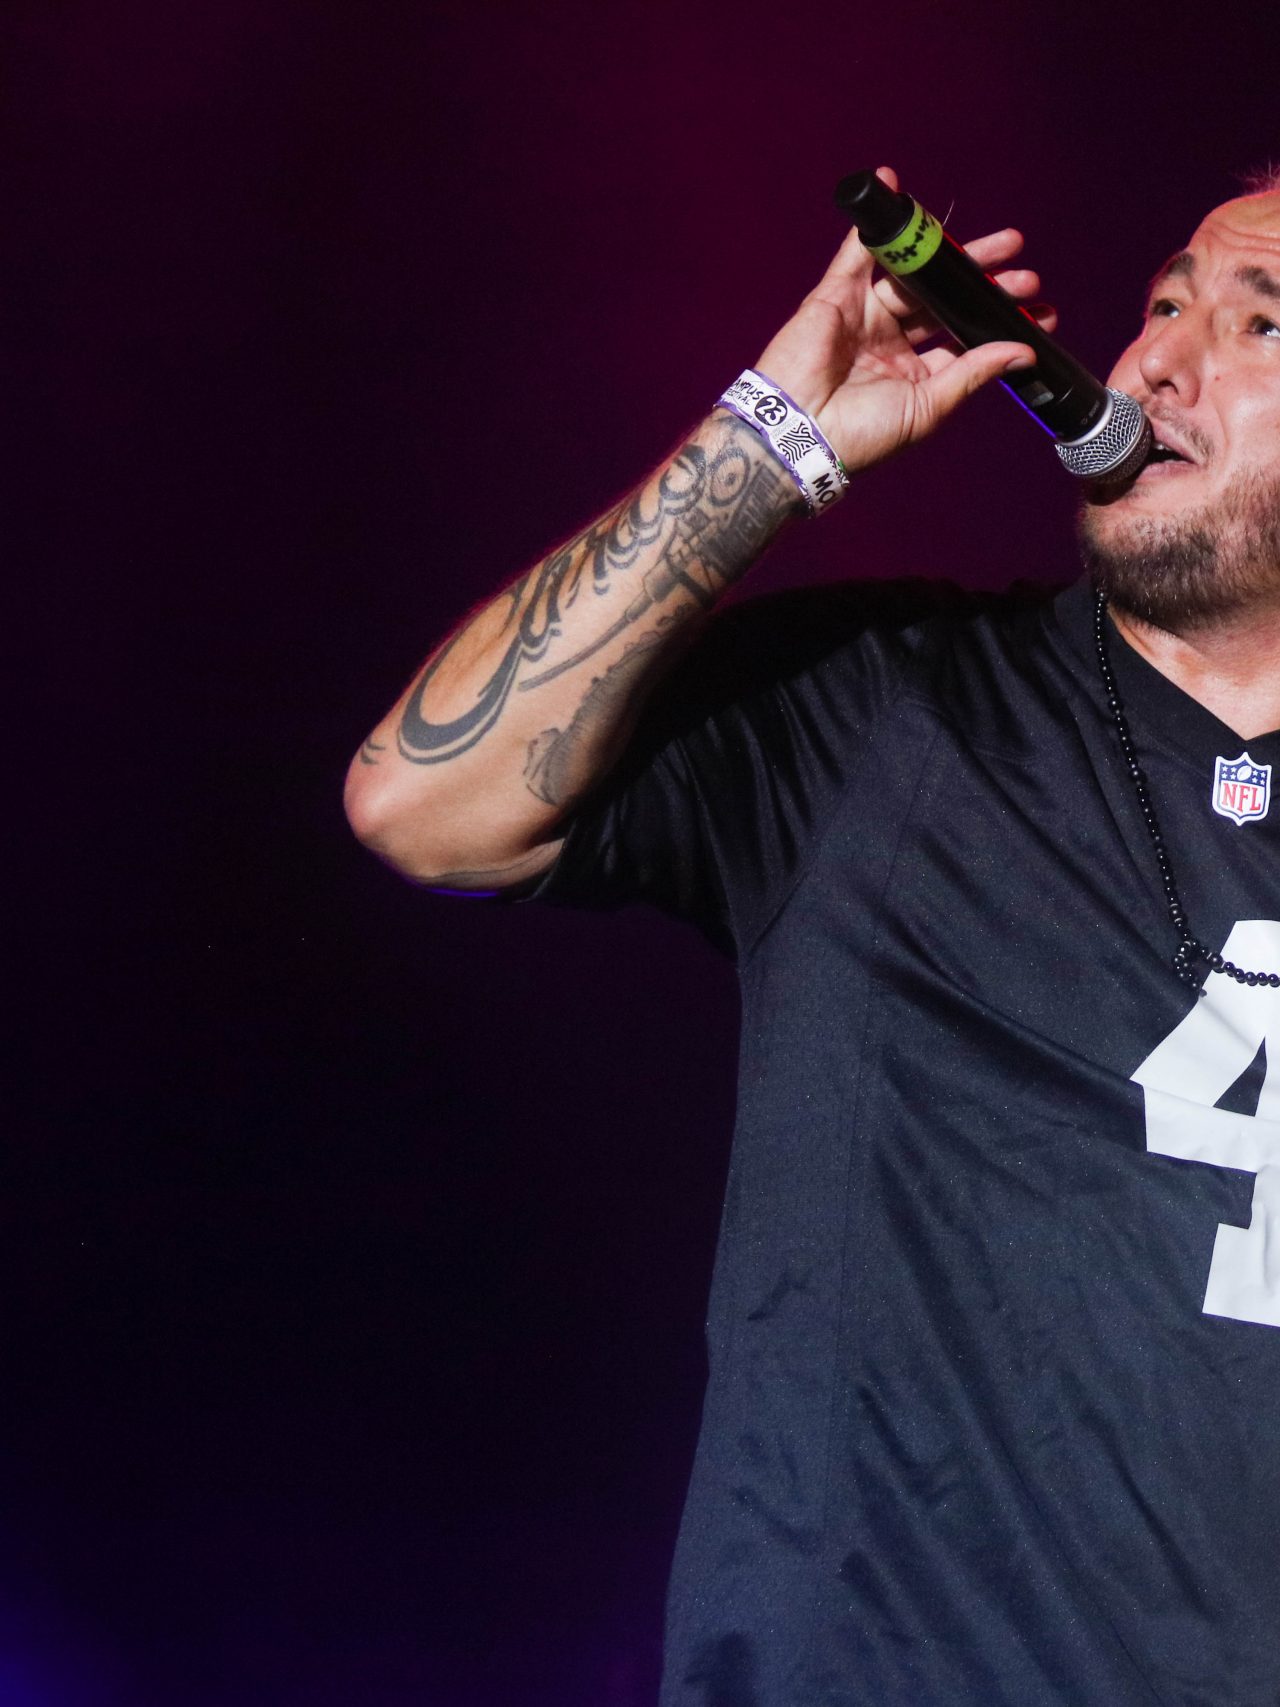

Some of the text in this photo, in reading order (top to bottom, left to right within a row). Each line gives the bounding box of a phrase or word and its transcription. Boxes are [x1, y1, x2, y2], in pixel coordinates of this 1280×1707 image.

[733, 378, 764, 401] AMPUS
[755, 396, 787, 426] 23
[812, 472, 837, 506] MO
[1221, 782, 1262, 814] NFL
